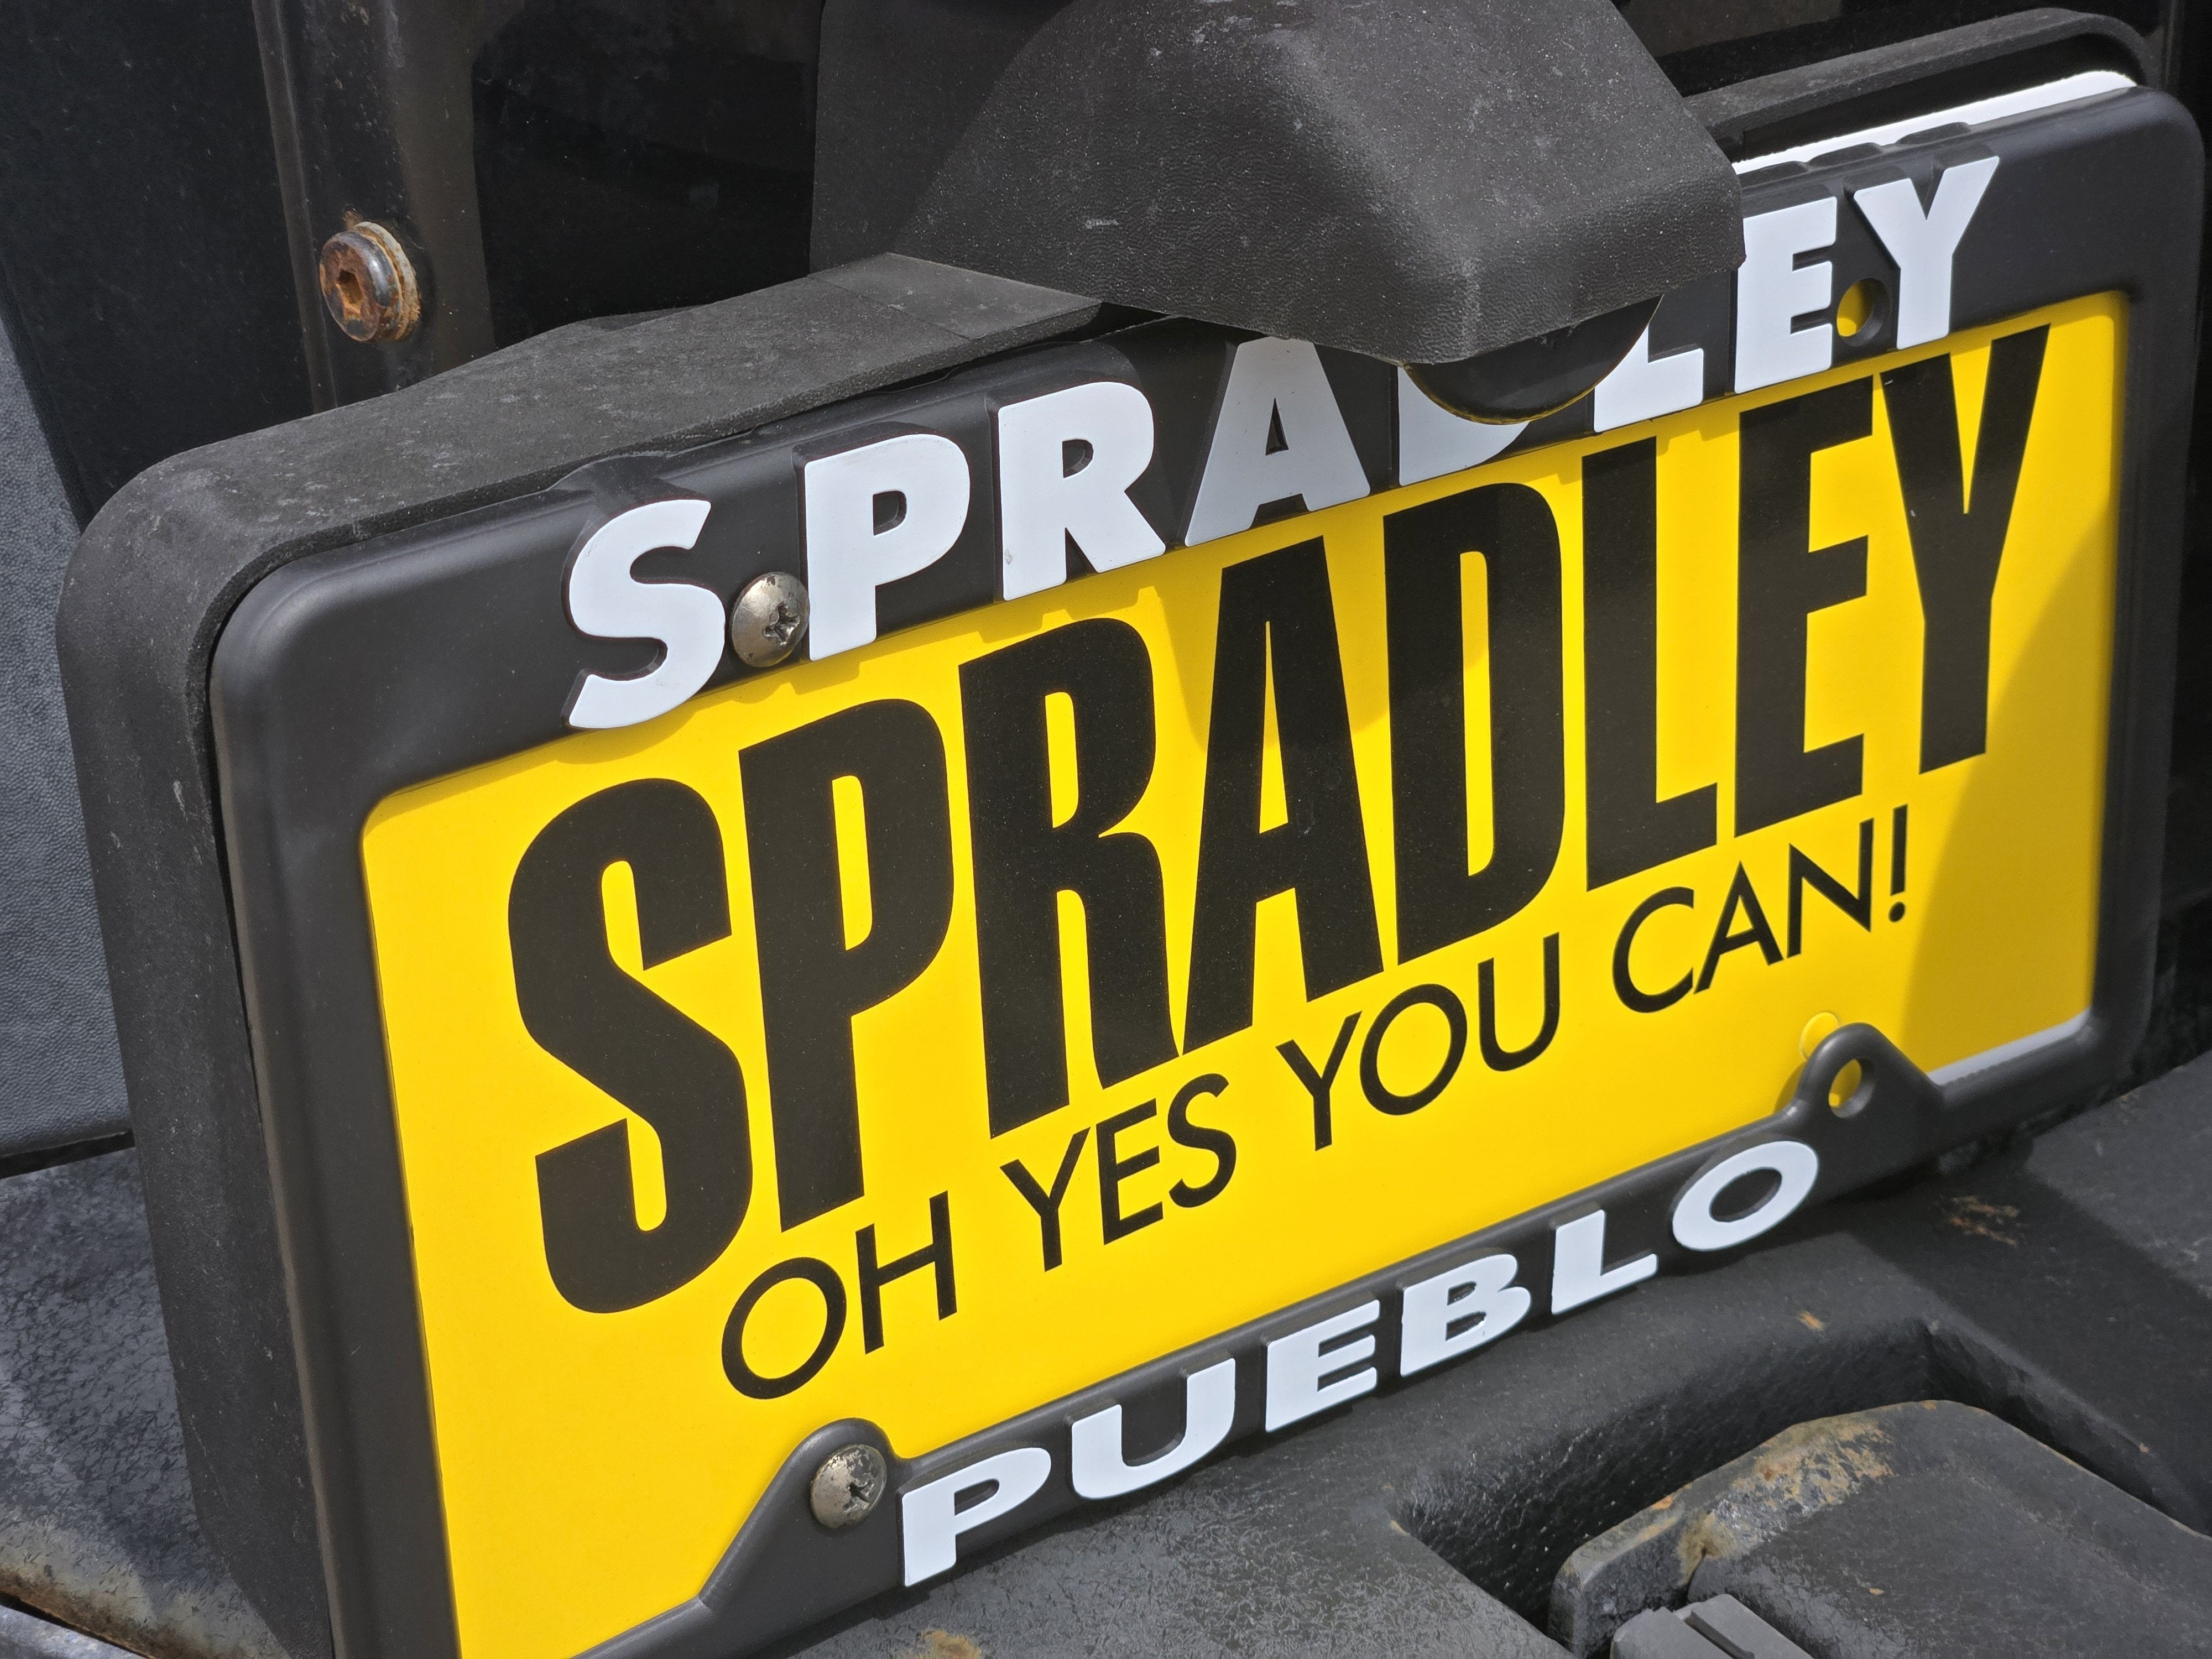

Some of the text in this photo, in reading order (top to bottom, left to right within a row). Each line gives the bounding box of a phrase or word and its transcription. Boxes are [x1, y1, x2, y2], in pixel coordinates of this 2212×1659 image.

[507, 322, 2052, 1314] SPRADLEY
[722, 804, 1908, 1400] OH YES YOU CAN!
[901, 1140, 1819, 1587] PUEBLO
